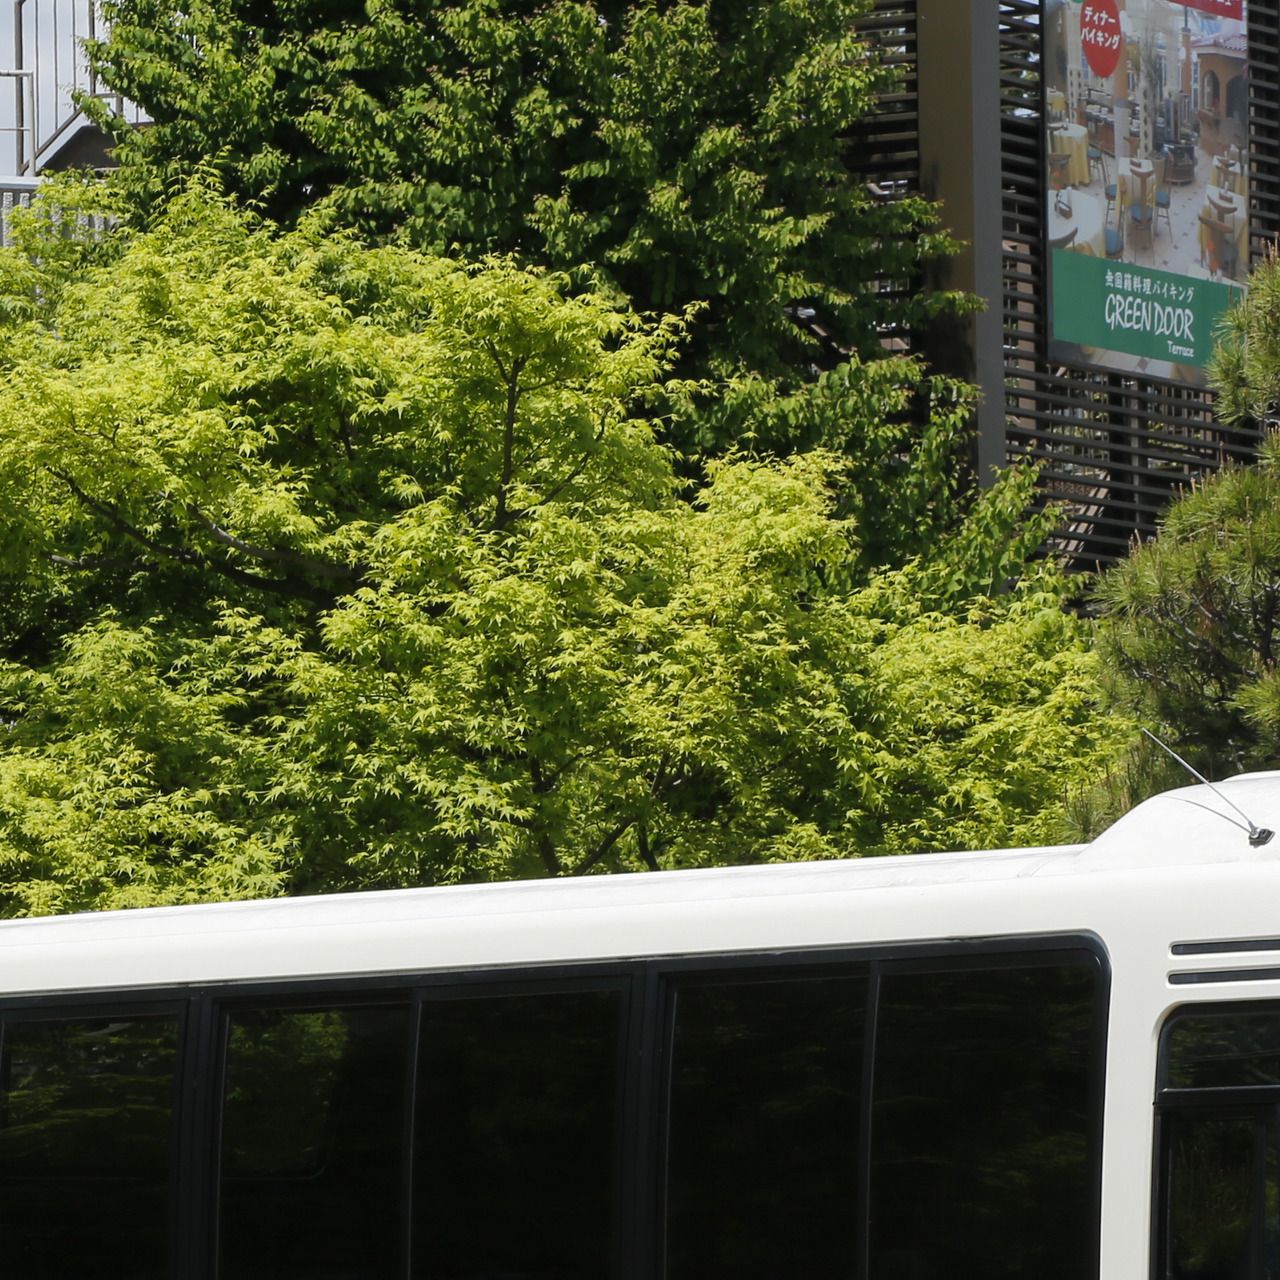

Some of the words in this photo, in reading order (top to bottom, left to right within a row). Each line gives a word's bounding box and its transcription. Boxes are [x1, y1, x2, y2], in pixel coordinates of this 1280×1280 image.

[1081, 27, 1120, 50] バイキング
[1105, 293, 1151, 331] GREEN
[1153, 301, 1195, 342] DOOR
[1167, 340, 1195, 358] Terrace
